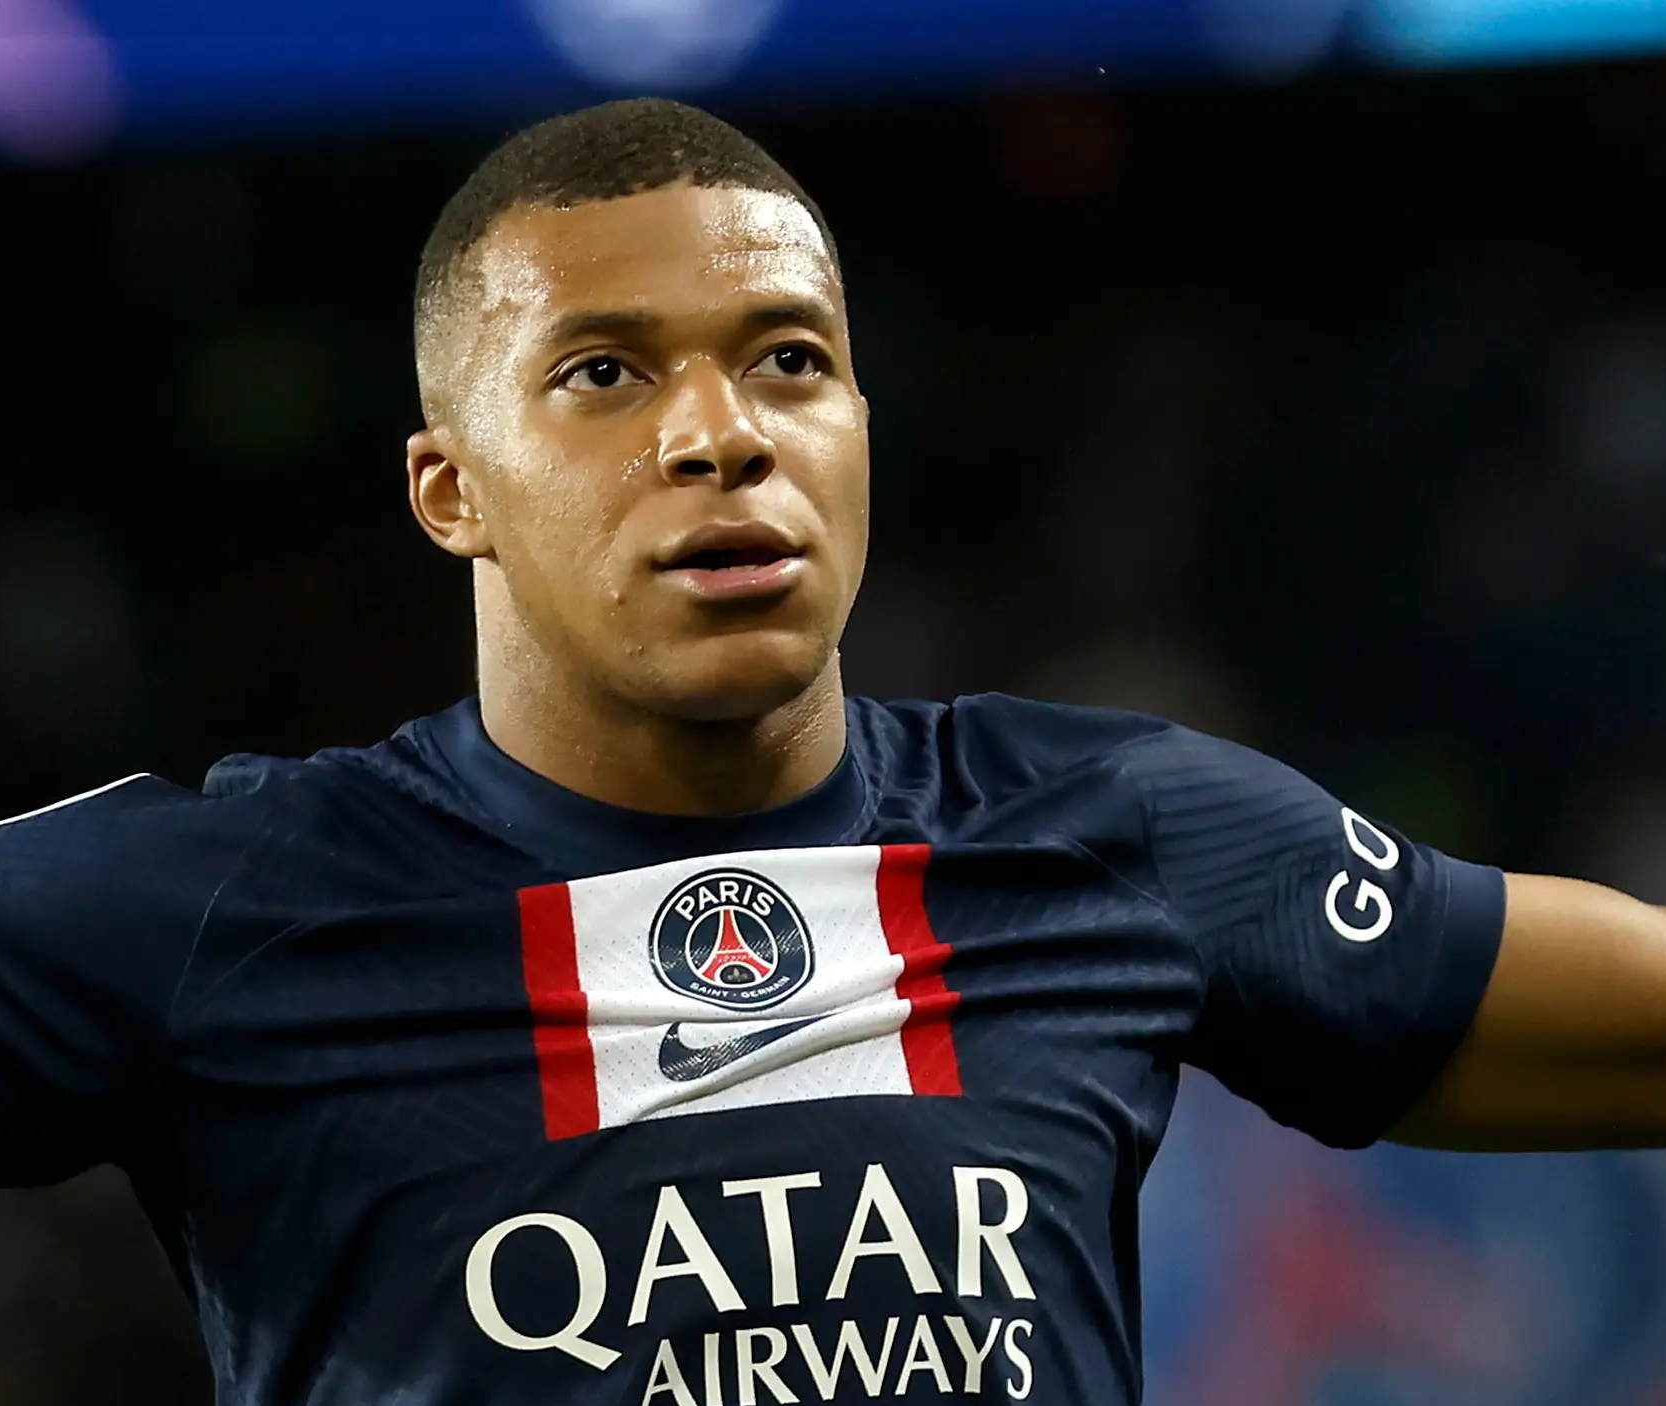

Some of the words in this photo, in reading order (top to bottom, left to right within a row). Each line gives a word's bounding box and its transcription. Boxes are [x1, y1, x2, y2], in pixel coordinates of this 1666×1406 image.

[674, 880, 775, 922] PARIS
[689, 982, 728, 998] SAINT
[464, 1162, 1038, 1372] QATAR
